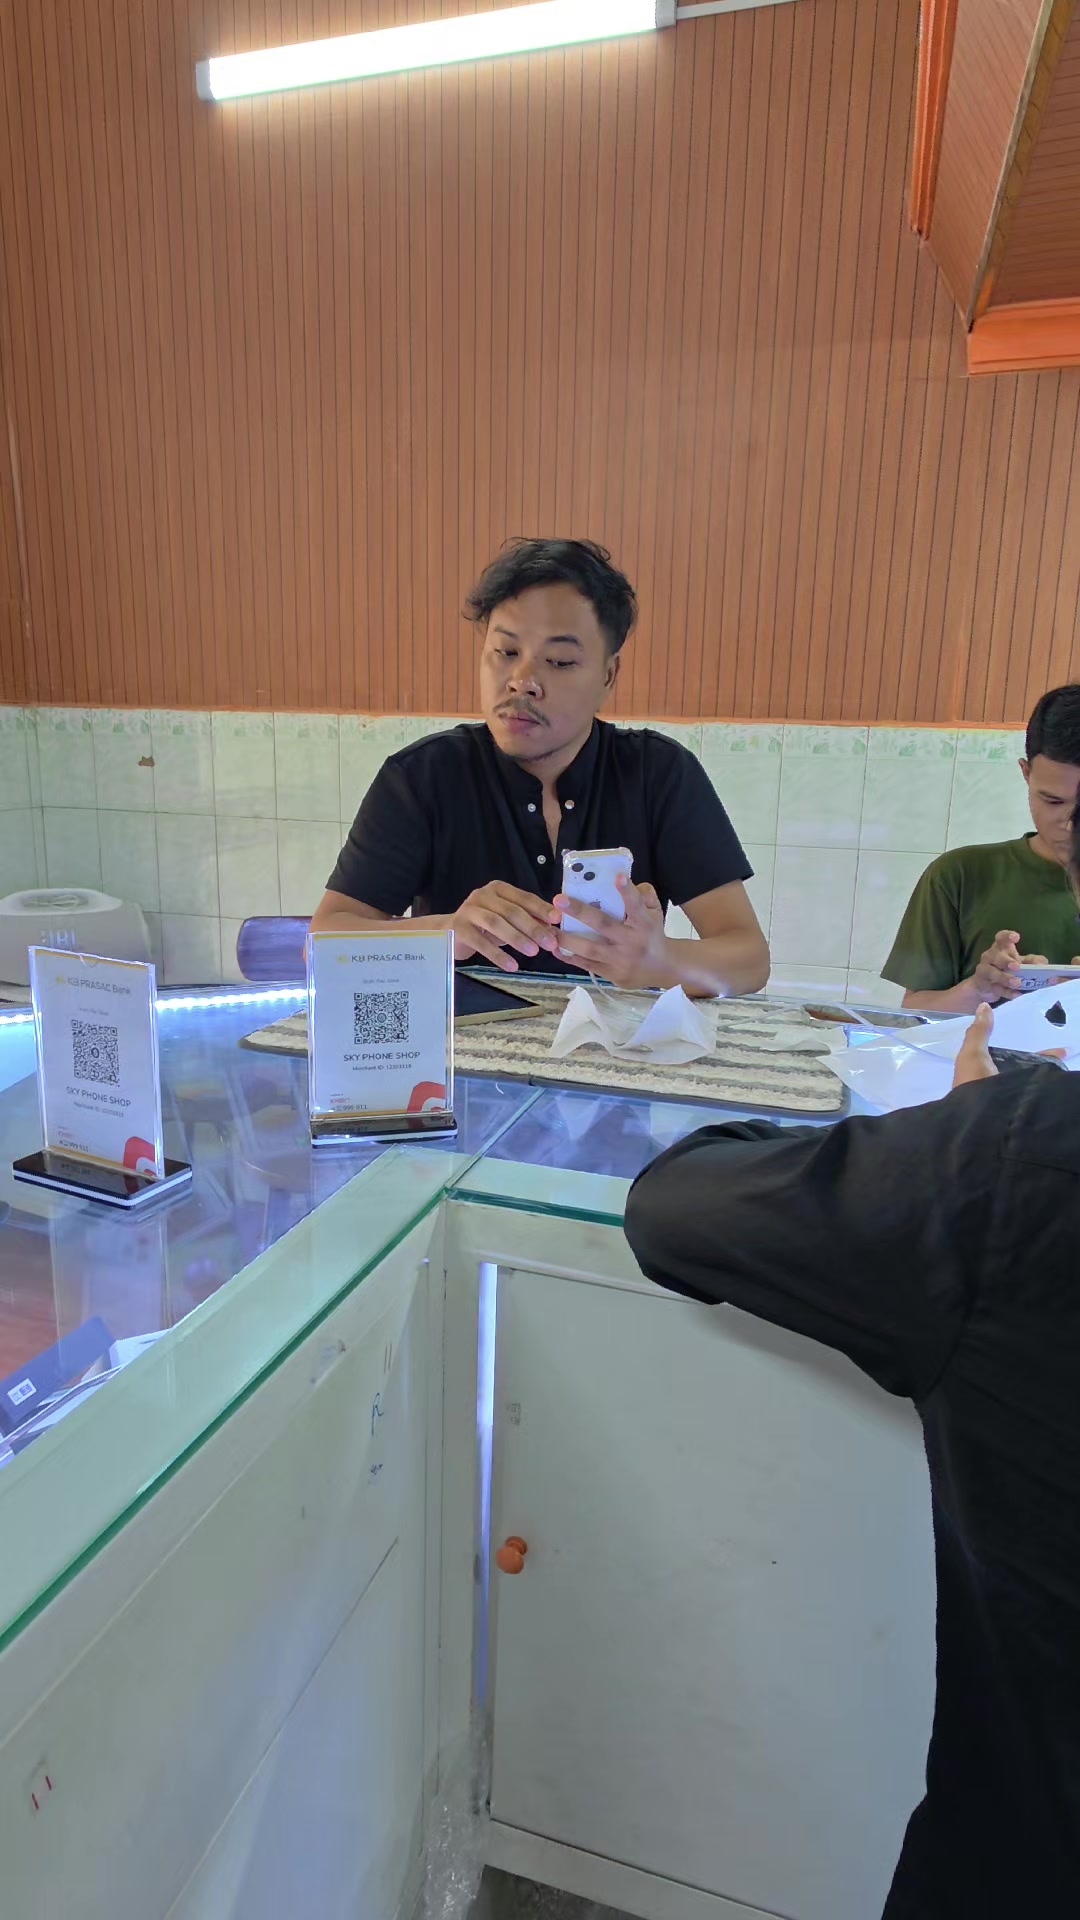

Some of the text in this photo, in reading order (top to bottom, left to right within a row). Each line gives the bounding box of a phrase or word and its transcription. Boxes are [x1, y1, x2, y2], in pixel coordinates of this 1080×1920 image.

[367, 952, 403, 962] PRASAC
[404, 952, 426, 961] Bank
[80, 979, 112, 993] PRASAC
[343, 1051, 421, 1062] SKY PHONE SHOP
[66, 1086, 132, 1108] SKY PHONE SHOP
